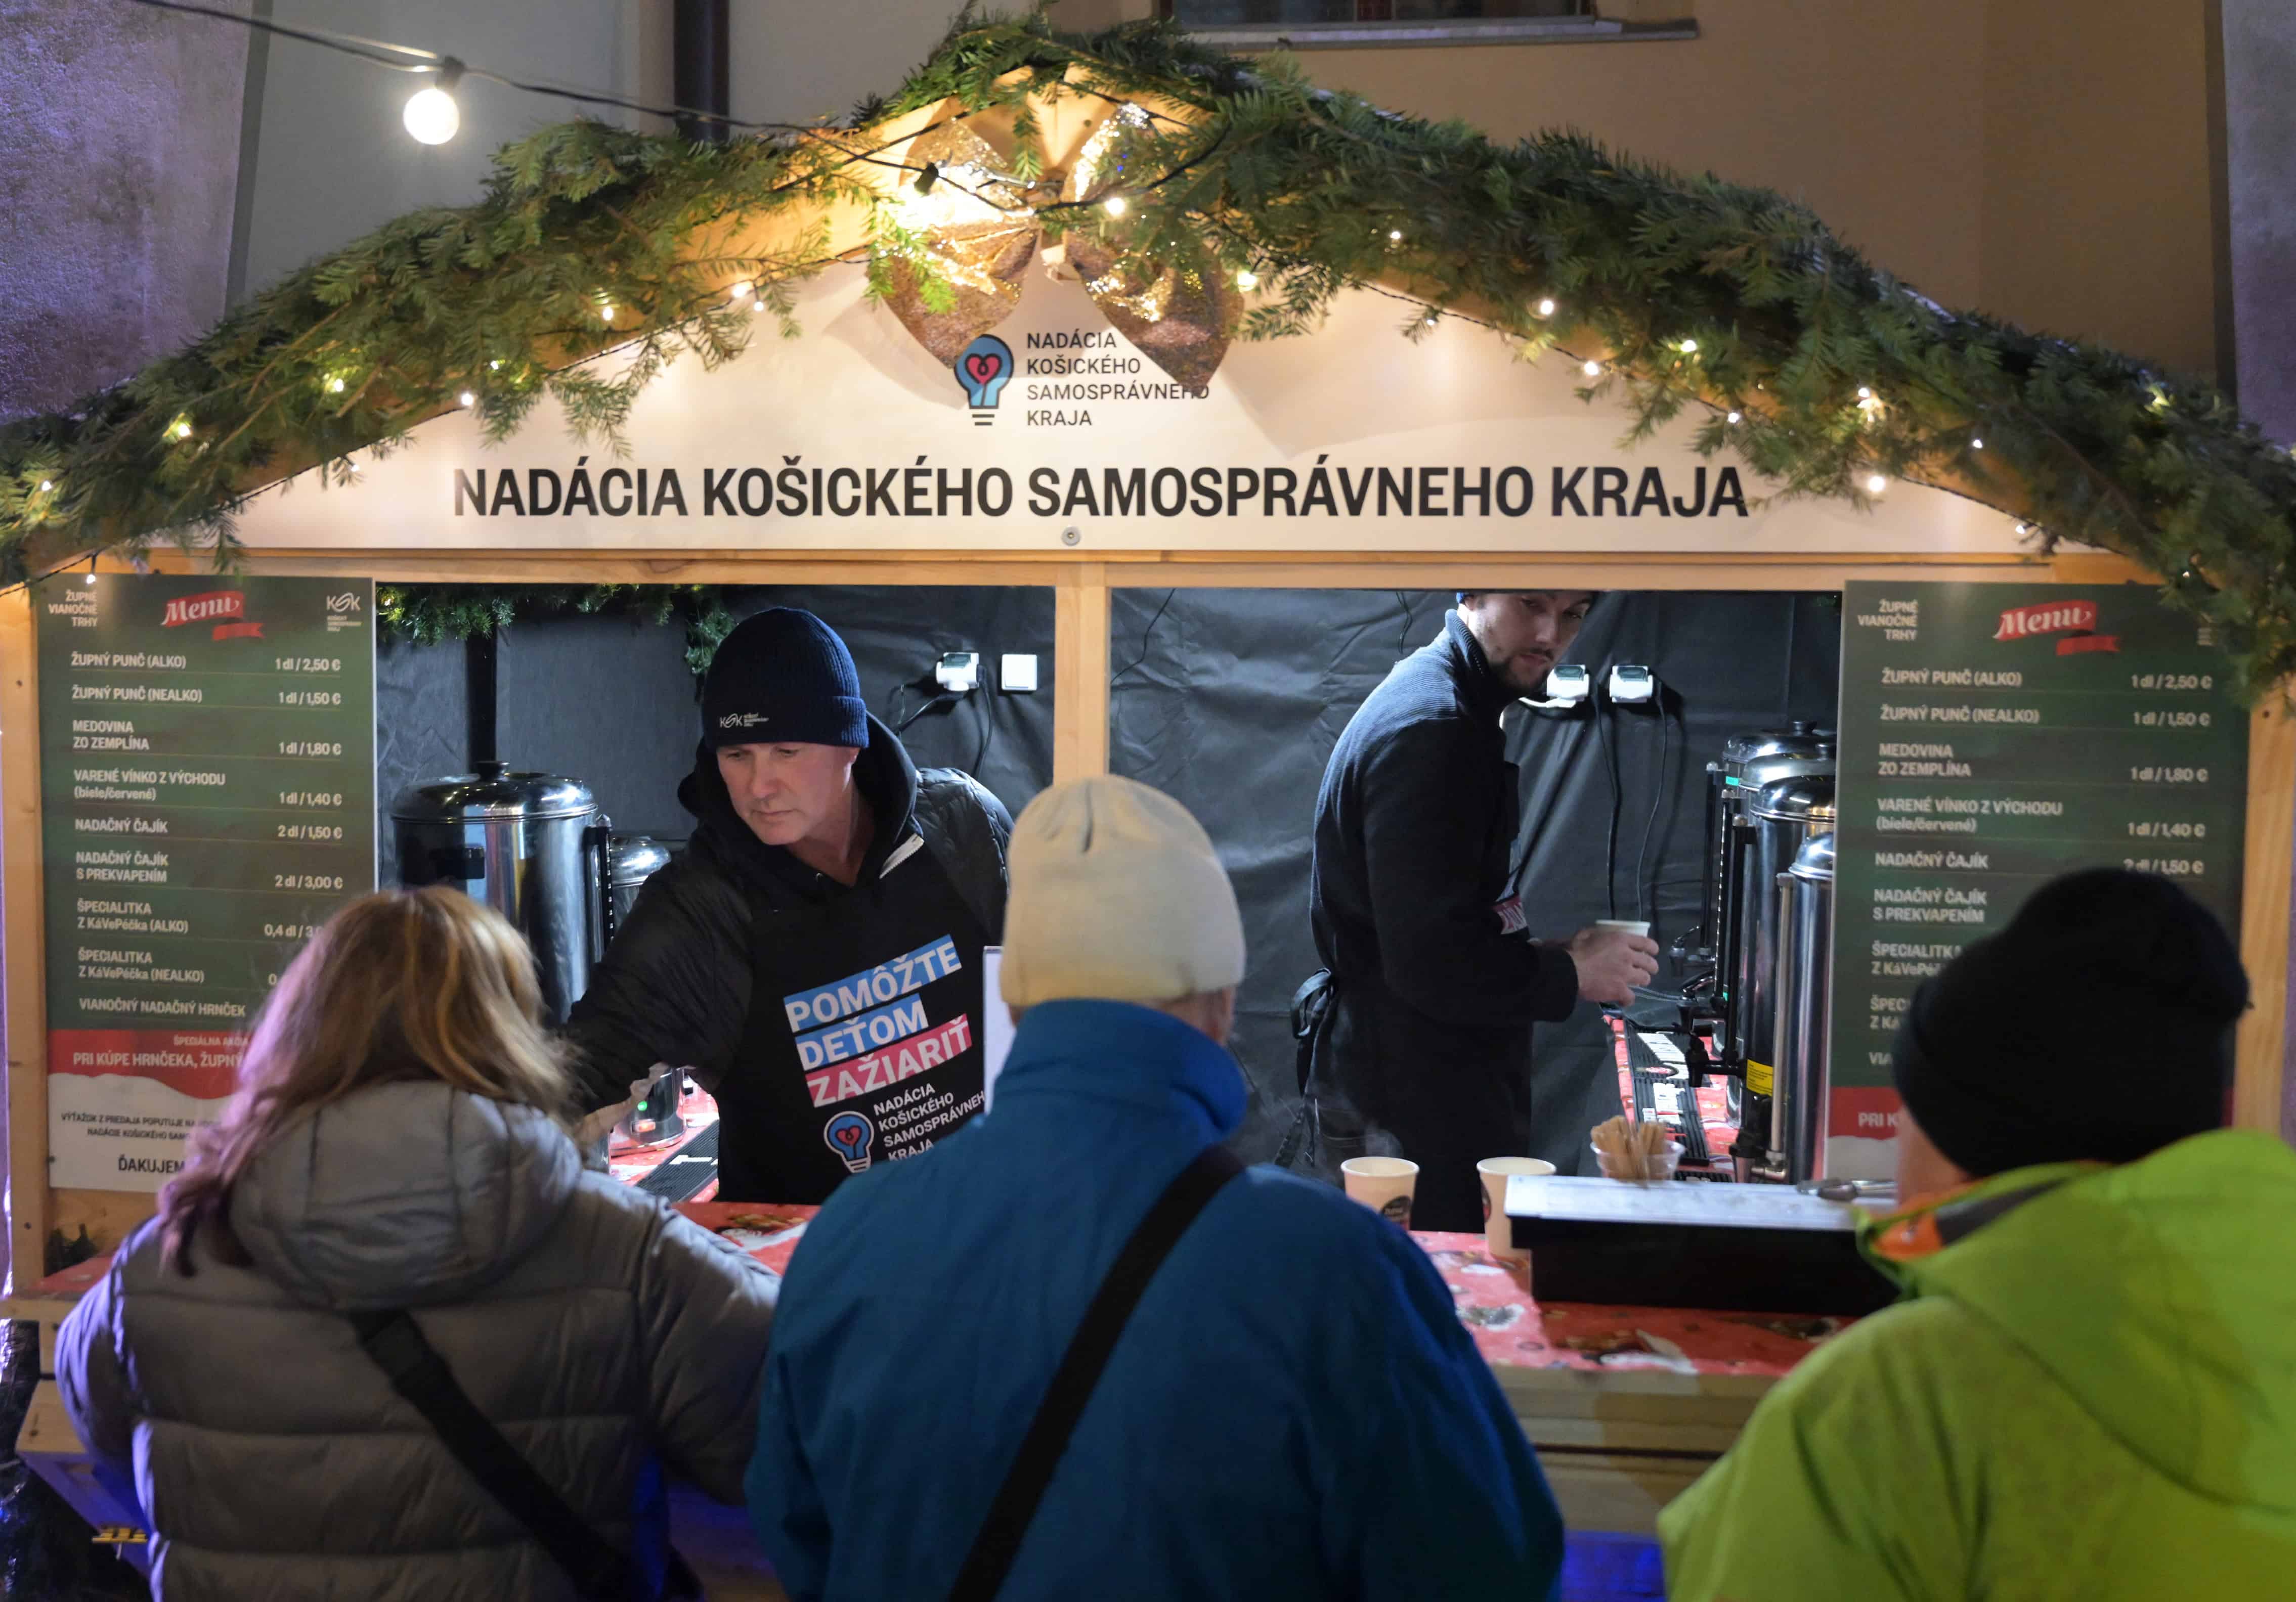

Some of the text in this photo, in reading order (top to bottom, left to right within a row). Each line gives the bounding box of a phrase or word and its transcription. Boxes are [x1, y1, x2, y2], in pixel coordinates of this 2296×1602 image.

[1027, 329, 1117, 349] NADÁCIA
[1027, 354, 1141, 374] KOŠICKÉHO
[1027, 410, 1093, 426] KRAJA
[454, 454, 1749, 517] NADÁCIA KOŠICKÉHO SAMOSPRÁVNEHO KRAJA
[160, 595, 240, 626] Menu
[72, 616, 98, 627] TRHY
[1993, 605, 2092, 639] Menu
[1885, 629, 1916, 640] TRHY
[71, 651, 187, 669] ŽUPNÝ PUNČ (ALKO)
[303, 658, 330, 672] 2,50
[1881, 668, 2022, 686] ŽUPNÝ PUNČ (ALKO)
[2164, 674, 2198, 690] 2,50
[72, 685, 202, 703] ŽUPNÝ PUNČ (NEALKO)
[307, 692, 330, 706] 1,50
[1880, 704, 2039, 723] ŽUPNÝ PUNČ (NEALKO)
[73, 720, 134, 733] MEDOVINA
[73, 735, 149, 750] ZO ZEMPLÍNA
[307, 742, 330, 756] 1,80
[1879, 743, 1953, 757] MEDOVINA
[74, 768, 226, 785] VARENÉ VÍNKO Z VÝCHODU
[1878, 761, 1971, 776] ZO ZEMPLÍNA
[307, 792, 331, 807] 1,40
[1877, 796, 2062, 815] VARENÉ VÍNKO Z VÝCHODU
[75, 817, 167, 833] NADAČNÝ ČAJÍK
[278, 825, 286, 837] 2
[308, 826, 331, 840] 1,50
[76, 850, 168, 866] NADAČNÝ ČAJÍK
[1875, 851, 1988, 868] NADAČNÝ ČAJÍK
[76, 868, 167, 882] S PREKVAPENÍM
[275, 874, 283, 887] 2
[305, 875, 332, 889] 3,00
[1874, 886, 1986, 905] NADAČNÝ ČAJÍK
[77, 898, 152, 915] ŠPECIALITKA
[1873, 906, 1984, 922] S PREKVAPENÍM
[78, 916, 85, 928] Z
[149, 919, 188, 933] (ALKO)
[264, 923, 284, 939] 0,4
[78, 946, 152, 963] ŠPECIALITKA
[79, 965, 86, 977] Z
[151, 968, 204, 984] (NEALKO)
[1872, 961, 1881, 974] Z
[785, 942, 962, 1033] POMÔŽTE
[79, 997, 246, 1017] VIANOČNÝ NADAČNÝ HRNČEK
[1870, 1015, 1879, 1029] Z
[796, 999, 929, 1071] DEŤOM
[73, 1053, 94, 1065] PRI
[97, 1050, 130, 1066] KÚPE
[807, 1016, 969, 1107] ZAŽIARIŤ
[874, 1083, 935, 1116] NADÁCIA
[879, 1092, 954, 1131] KOŠICKÉHO
[884, 1090, 985, 1147] SAMOSPRÁVNEH
[1858, 1112, 1884, 1127] PRI
[888, 1138, 934, 1162] KRAJA
